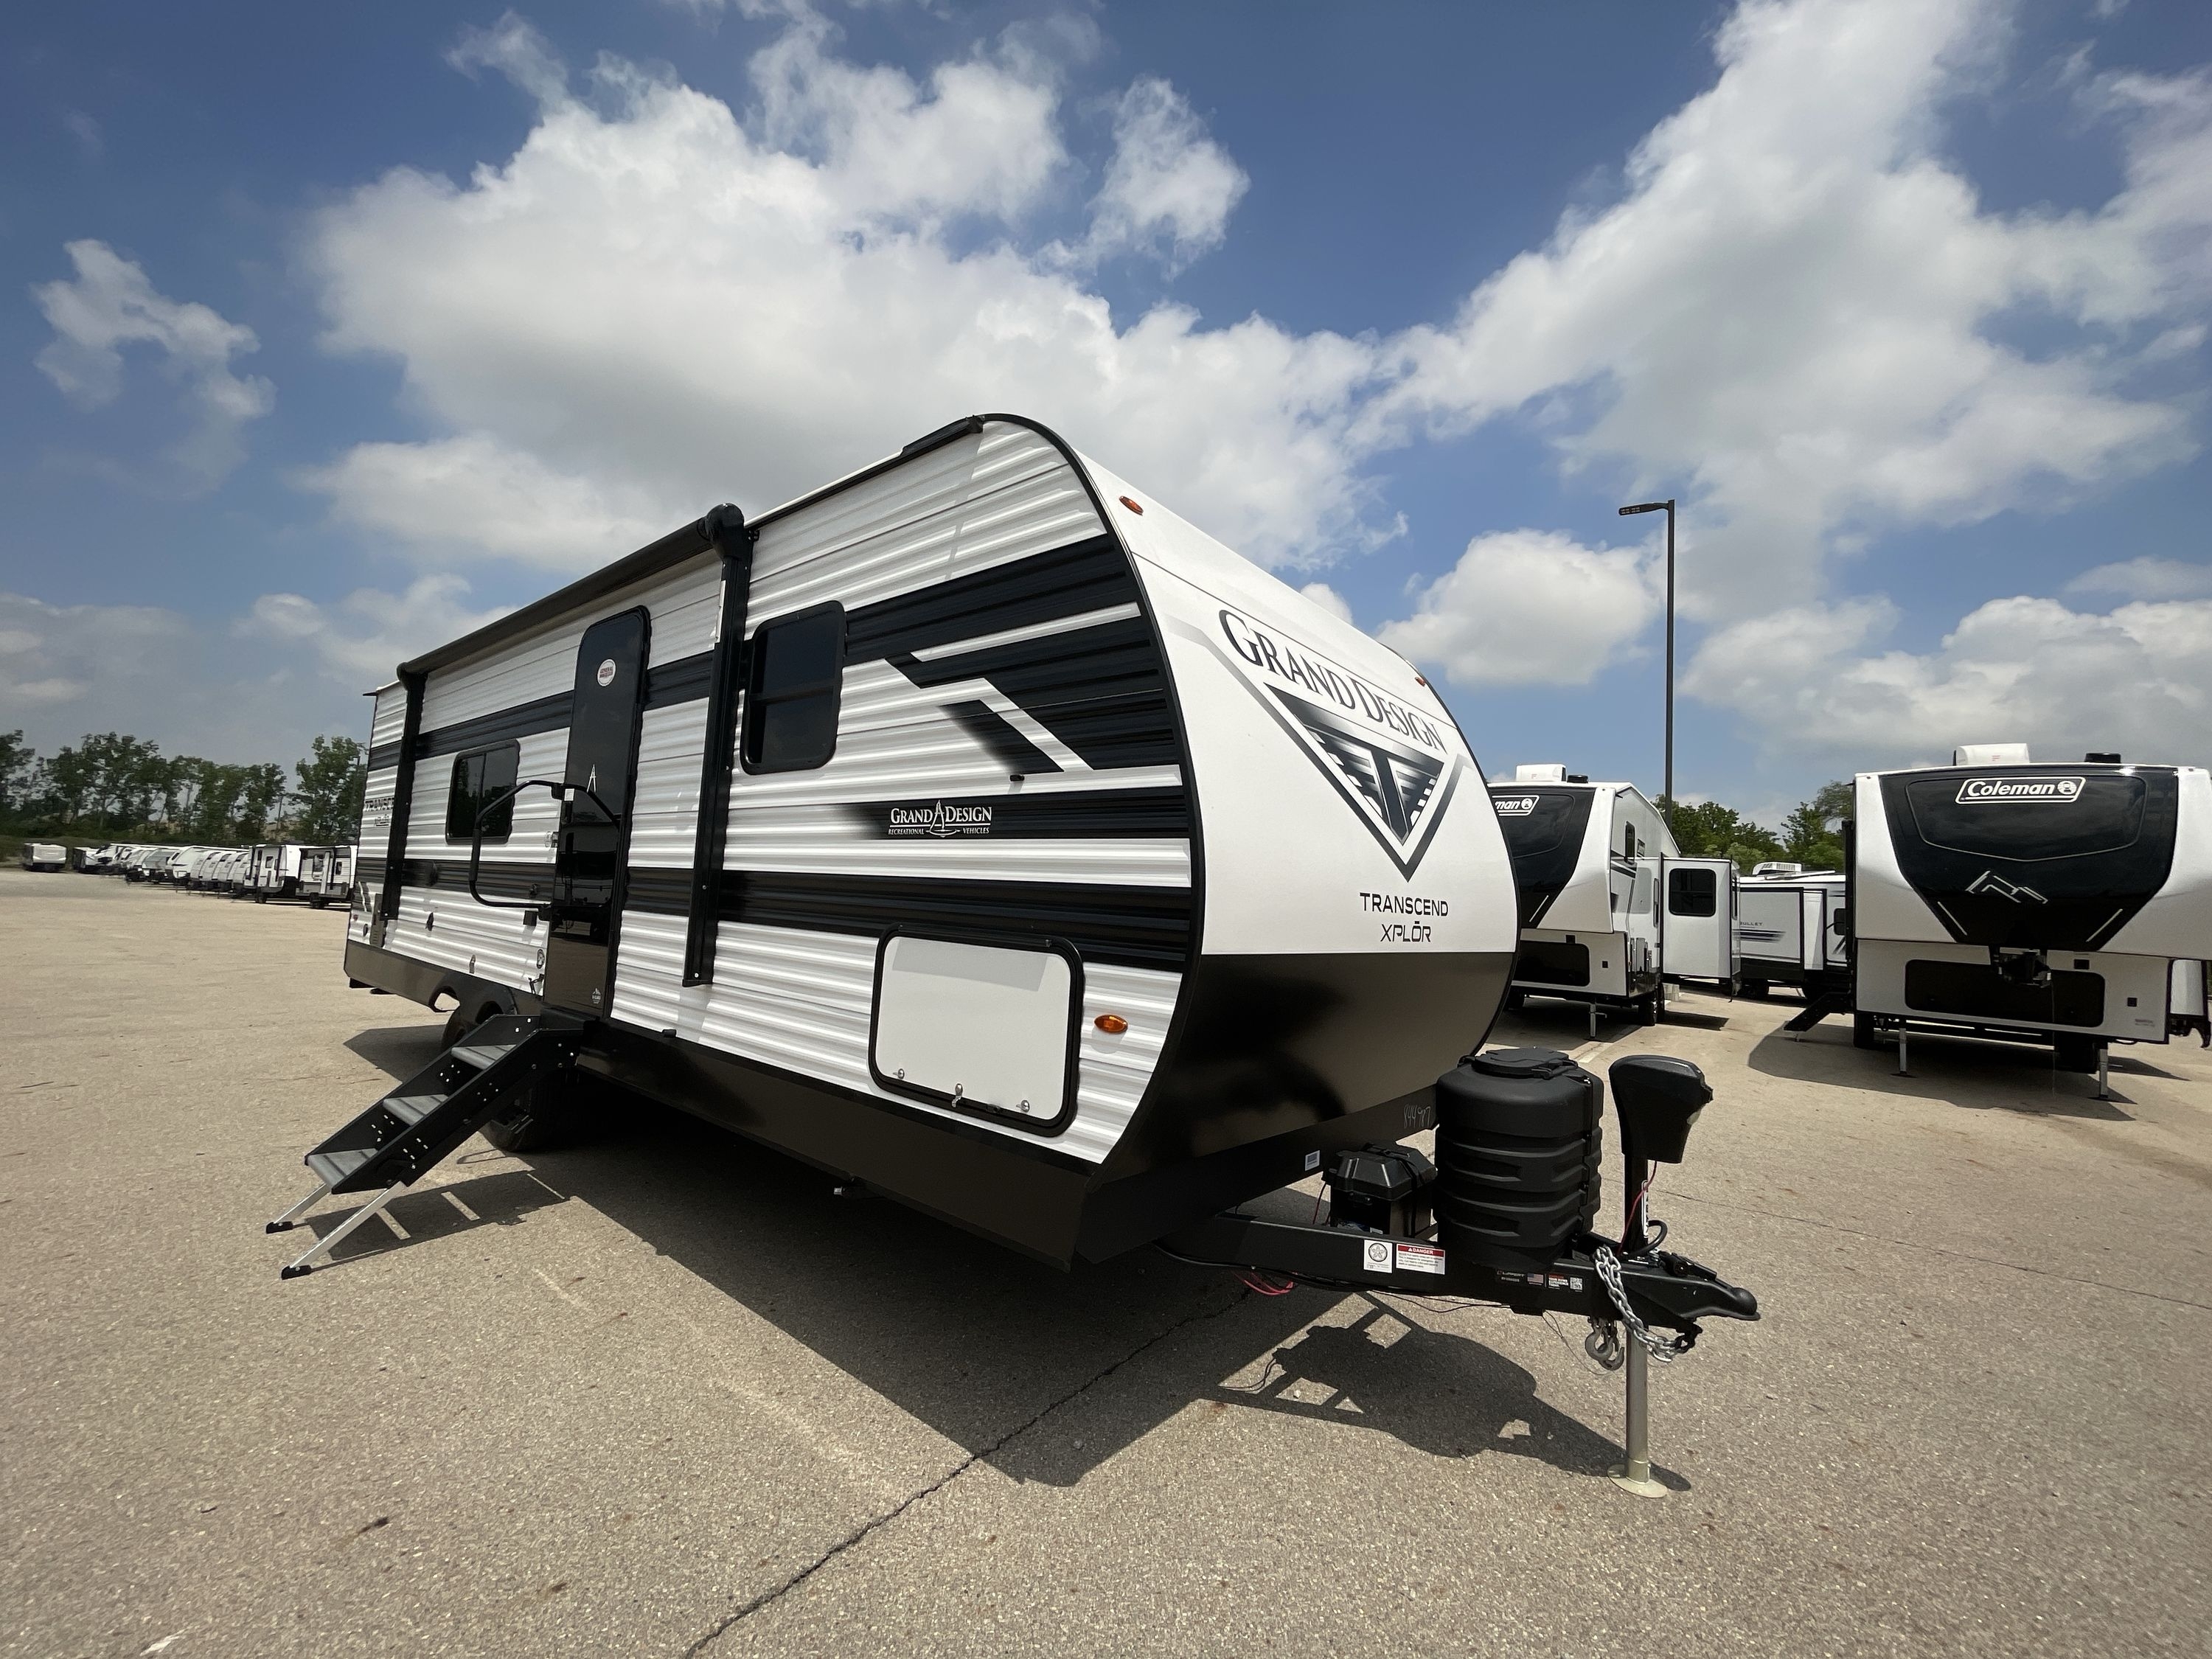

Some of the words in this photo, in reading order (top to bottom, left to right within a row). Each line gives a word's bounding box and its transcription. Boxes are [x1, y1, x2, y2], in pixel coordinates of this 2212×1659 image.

[1219, 609, 1356, 710] GRAND
[1349, 673, 1447, 754] DESIGN
[1967, 780, 2056, 797] Coleman
[890, 807, 933, 824] GRAND
[945, 806, 992, 822] DESIGN
[1360, 892, 1449, 917] TRANSCEND
